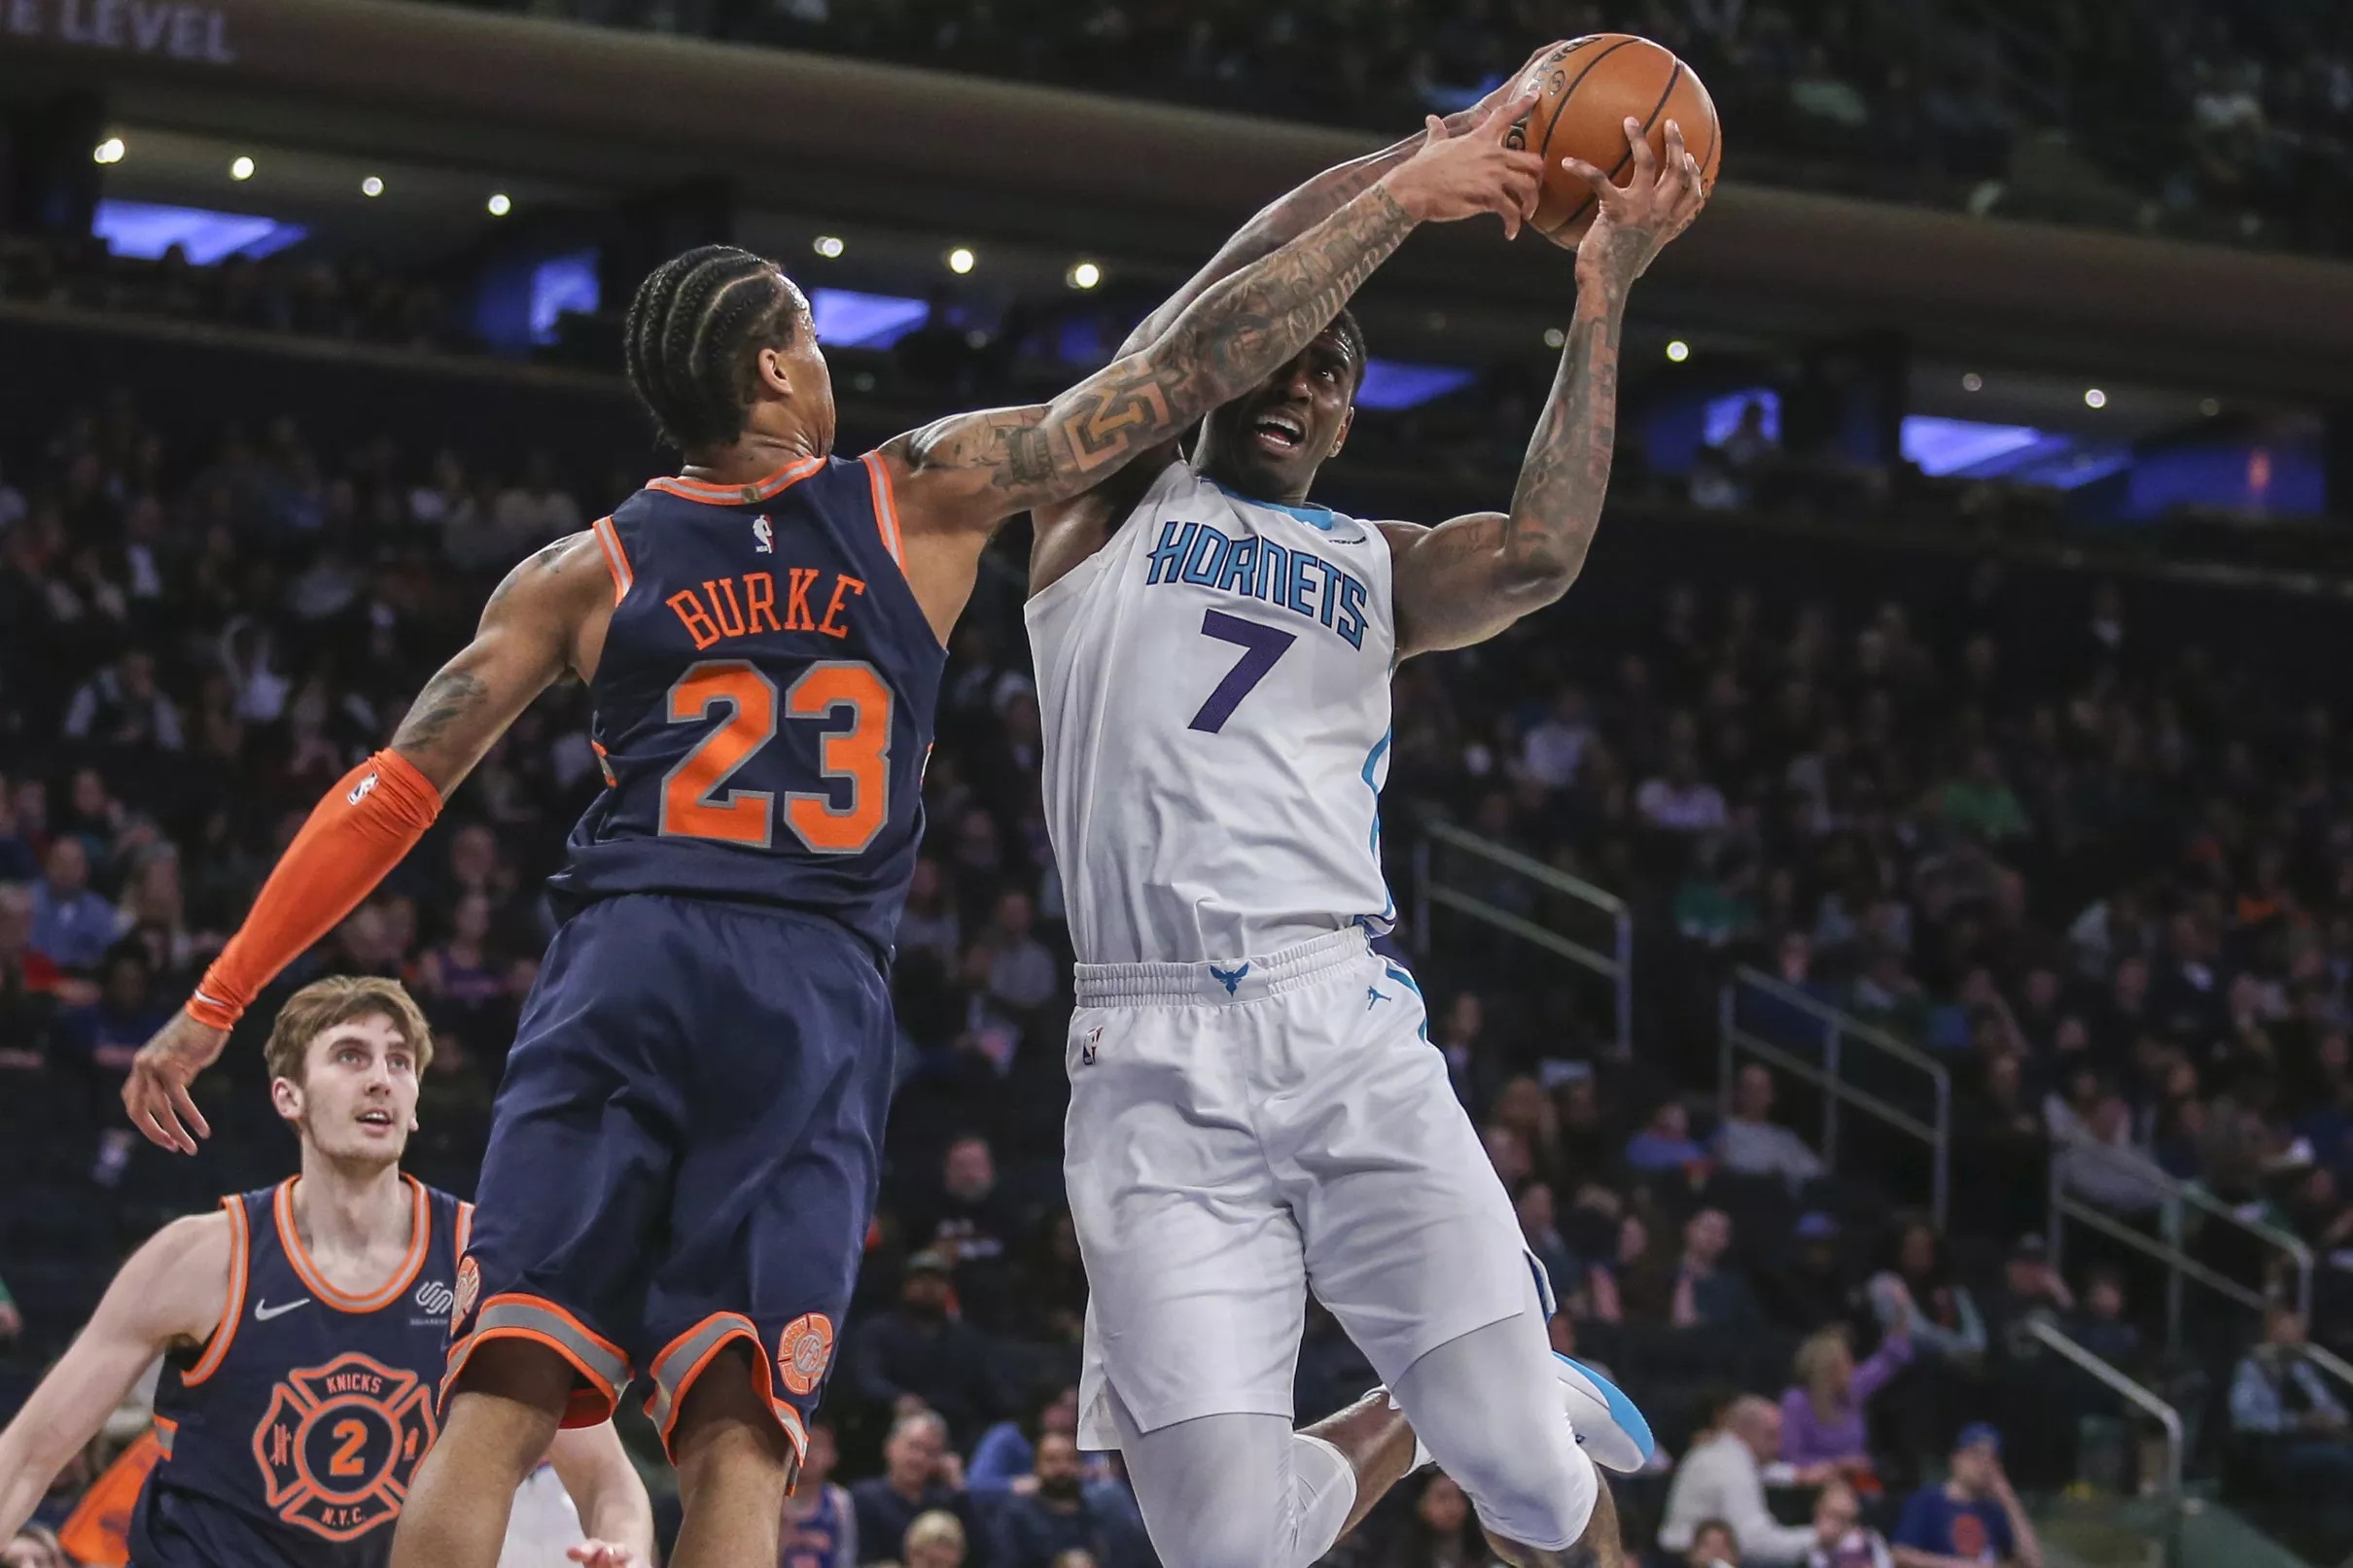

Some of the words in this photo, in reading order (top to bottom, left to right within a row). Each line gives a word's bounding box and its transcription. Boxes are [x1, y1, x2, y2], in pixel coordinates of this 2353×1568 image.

[60, 0, 239, 64] LEVEL
[666, 568, 866, 650] BURKE
[1146, 521, 1369, 651] HORNETS
[1187, 609, 1298, 734] 7
[658, 658, 895, 854] 23
[326, 1373, 383, 1394] KNICKS
[330, 1419, 369, 1477] 2
